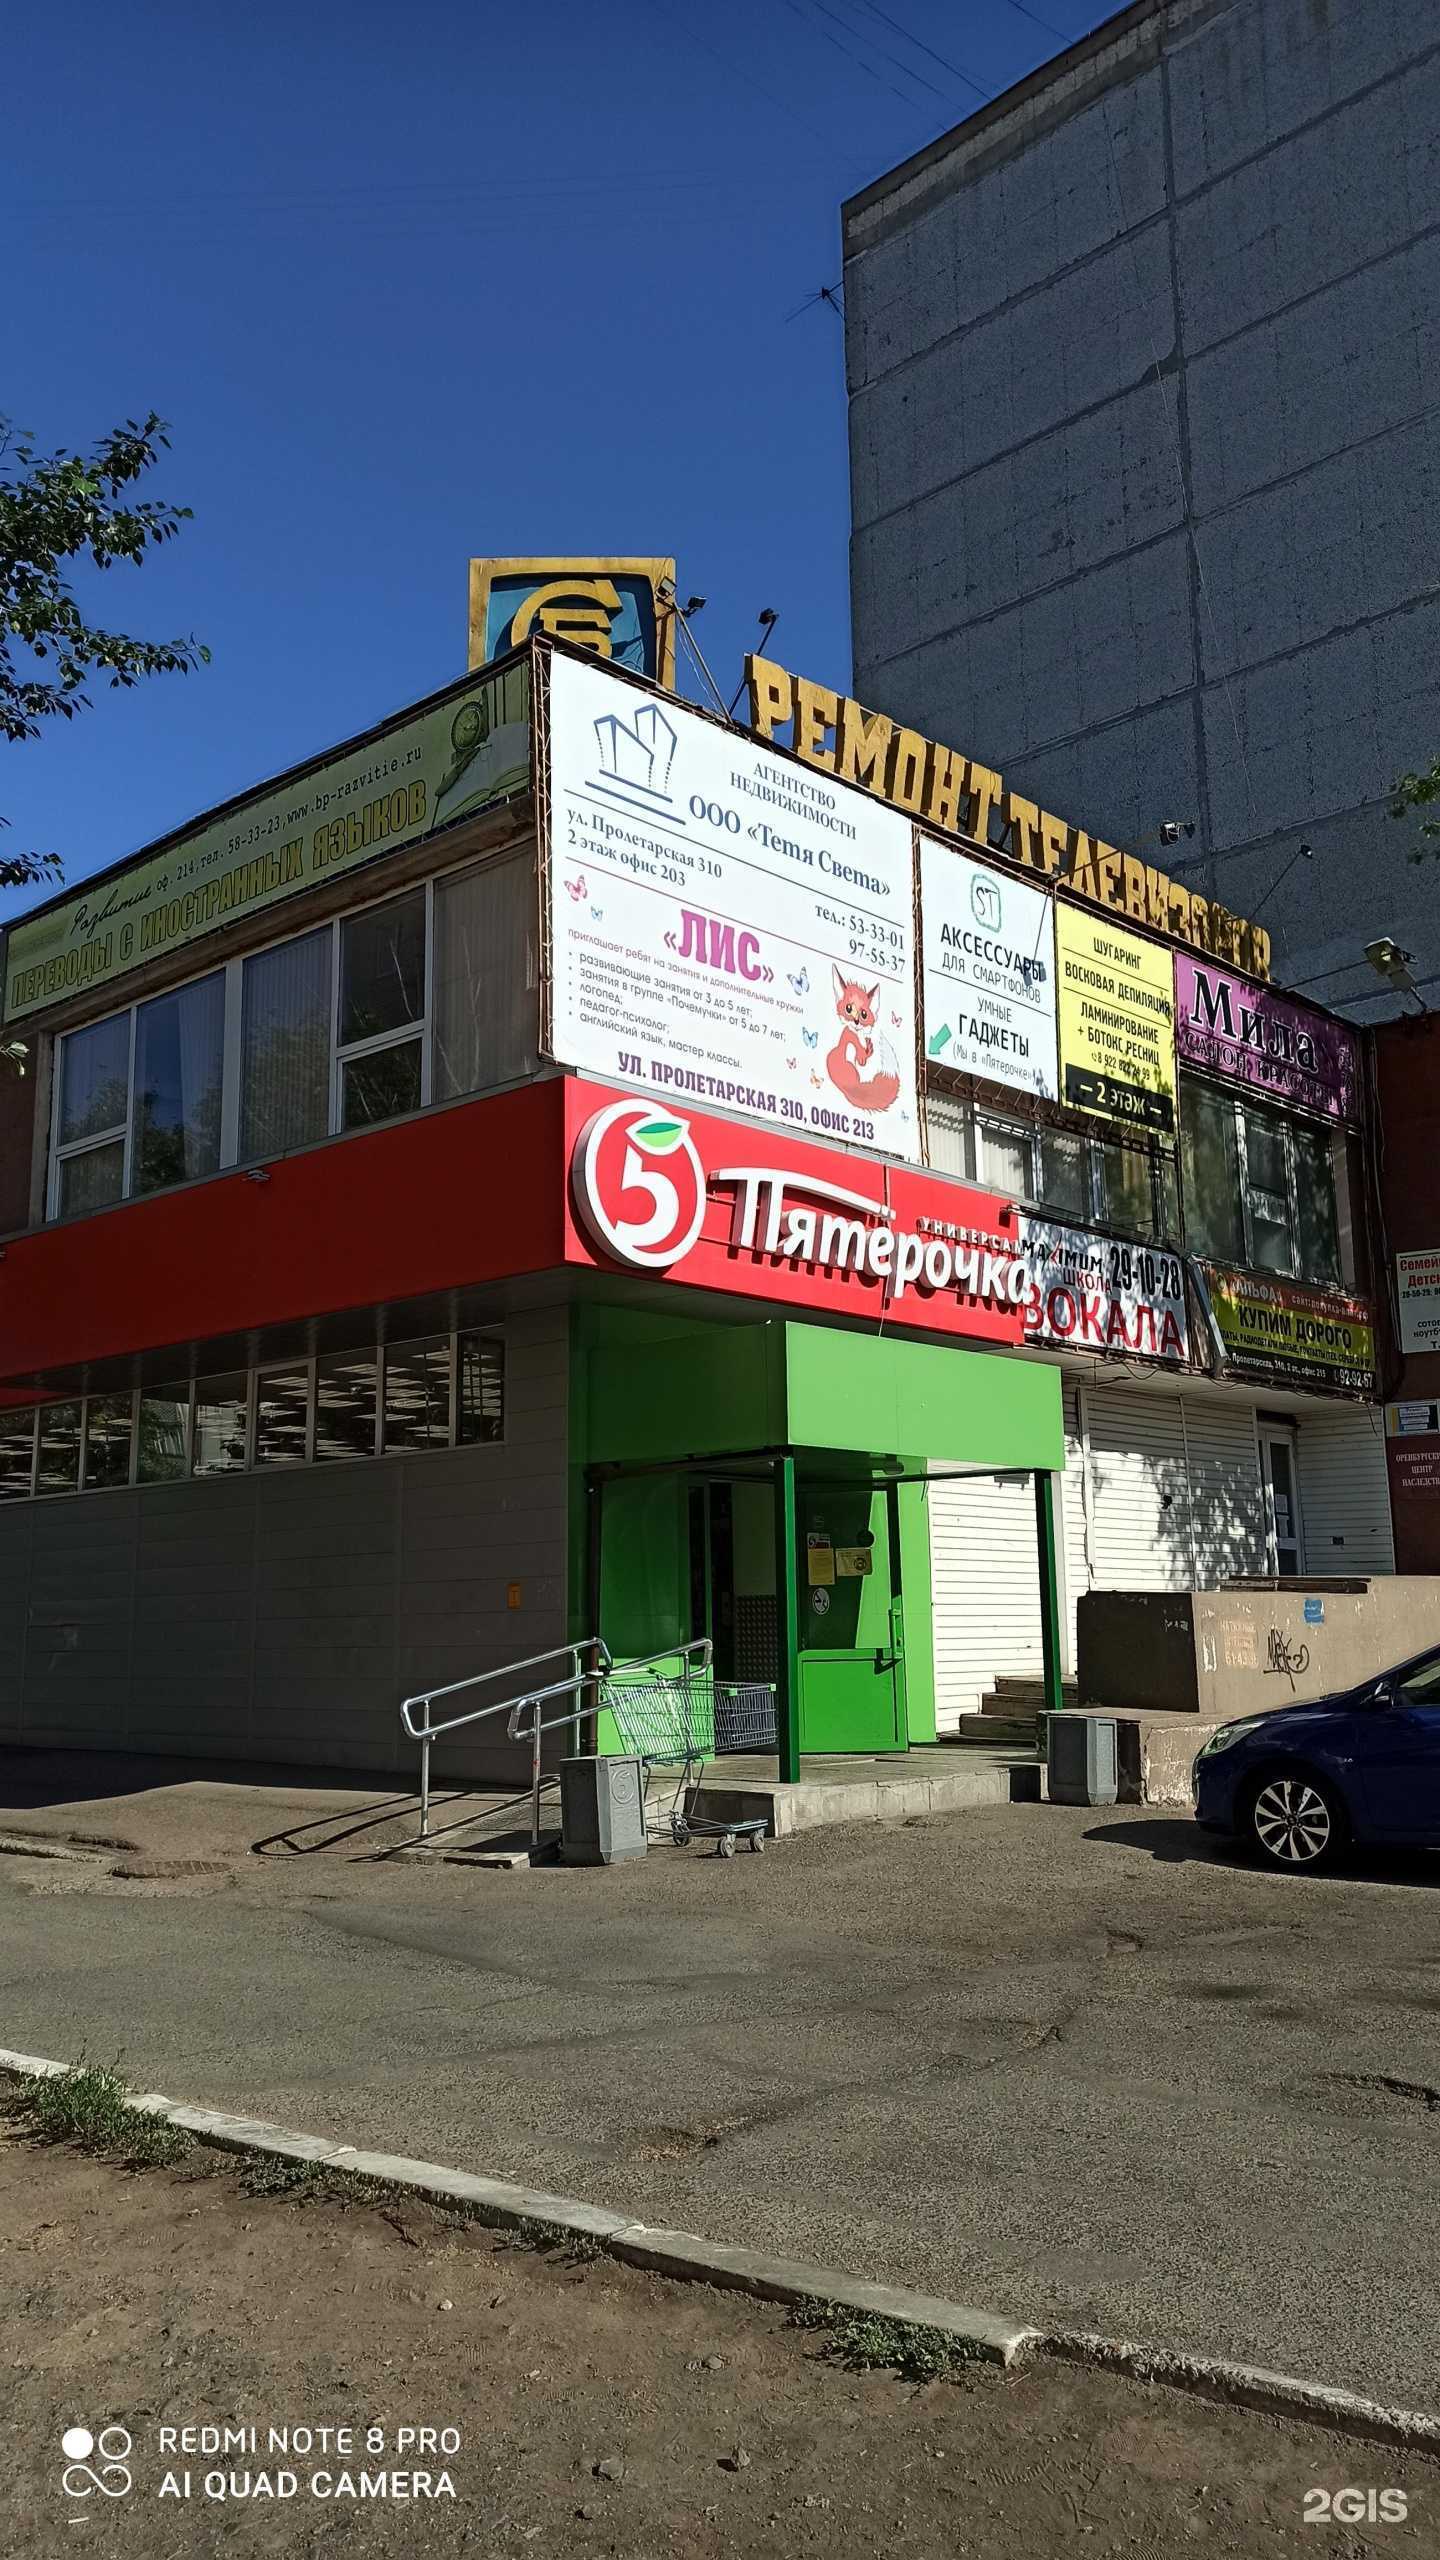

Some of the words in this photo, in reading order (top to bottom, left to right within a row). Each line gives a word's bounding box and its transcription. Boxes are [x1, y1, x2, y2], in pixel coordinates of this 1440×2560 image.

[744, 653, 1002, 848] РЕМОНТ
[730, 771, 857, 840] НЕДВИЖИМОСТИ
[753, 762, 836, 810] АГЕНТСТВО
[567, 808, 588, 826] ул.
[592, 814, 694, 868] Пролетарская
[698, 857, 723, 879] 310
[568, 829, 577, 845] 2
[580, 837, 617, 861] этаж
[620, 852, 657, 875] офис
[661, 864, 686, 886] 203
[689, 795, 741, 835] ООО
[747, 823, 814, 866] «Тетя
[819, 849, 891, 898] Света»
[11, 932, 113, 1009] ПЕРЕВОДЫ
[119, 923, 134, 960] С
[140, 837, 304, 952] ИНОСТРАННЫХ
[312, 779, 427, 870] ЯЗЫКОВ
[70, 888, 152, 938] Развитие
[976, 887, 998, 920] ST
[663, 909, 775, 983] «ЛИС»
[814, 904, 846, 926] тел.:
[849, 914, 904, 950] 53-33-01
[568, 928, 623, 953] приглашает
[625, 948, 651, 963] ребят
[654, 957, 665, 968] на
[667, 963, 700, 979] занятия
[710, 977, 774, 1005] дополнительные
[776, 1000, 804, 1015] кружки
[848, 938, 906, 974] 97-55-37
[940, 923, 1042, 982] АКСЕССУАРЫ
[942, 951, 965, 974] ДЛЯ
[972, 963, 1041, 1004] СМАРТФОНОВ
[1093, 937, 1141, 970] ШУГАРИНГ
[579, 953, 651, 984] развивающие
[654, 978, 691, 997] занятия
[693, 991, 703, 1001] от
[706, 992, 712, 1004] 3
[714, 998, 725, 1009] до
[728, 1000, 734, 1011] 5
[736, 1006, 753, 1019] лет;
[579, 983, 623, 1005] логопед;
[580, 968, 619, 988] занятия
[622, 981, 627, 991] в
[630, 984, 664, 1003] группе
[728, 1016, 738, 1026] от
[741, 1018, 747, 1029] 5
[749, 1023, 760, 1034] до
[762, 1025, 768, 1035] 7
[770, 1030, 786, 1042] лет;
[977, 996, 1013, 1023] УМНЫЕ
[1065, 961, 1115, 994] ВОСКОВАЯ
[1118, 983, 1170, 1017] ДЕПИЛЯЦИЯ
[579, 997, 670, 1034] педагог-психолог;
[579, 1012, 638, 1037] английский
[640, 1031, 666, 1048] язык,
[668, 1039, 704, 1058] мастер
[706, 1050, 742, 1069] классы.
[959, 1014, 1029, 1058] ГАДЖЕТЫ
[1081, 1001, 1159, 1045] ЛАМИНИРОВАНИЕ
[1190, 966, 1319, 1074] Мила
[1087, 1026, 1123, 1053] БОТОКС
[1125, 1040, 1159, 1066] РЕСНИЦ
[1097, 1052, 1102, 1064] 8
[1104, 1055, 1117, 1069] 922
[1184, 1031, 1247, 1071] САЛОН
[618, 1051, 646, 1078] УЛ.
[651, 1060, 777, 1115] ПРОЛЕТАРСКАЯ
[780, 1097, 807, 1125] 310,
[811, 1105, 850, 1133] ОФИС
[853, 1118, 875, 1141] 213
[1097, 1081, 1106, 1104] 2
[1110, 1089, 1146, 1116] этаж
[1063, 1267, 1112, 1295] ШКОЛА
[1111, 1246, 1181, 1300] 29-10-28
[1400, 1255, 1440, 1272] Семей
[1024, 1282, 1184, 1356] ВОКАЛА
[1239, 1306, 1292, 1336] КУПИМ
[1296, 1318, 1351, 1349] ДОРОГО
[1411, 1465, 1433, 1474] ЦЕНТР
